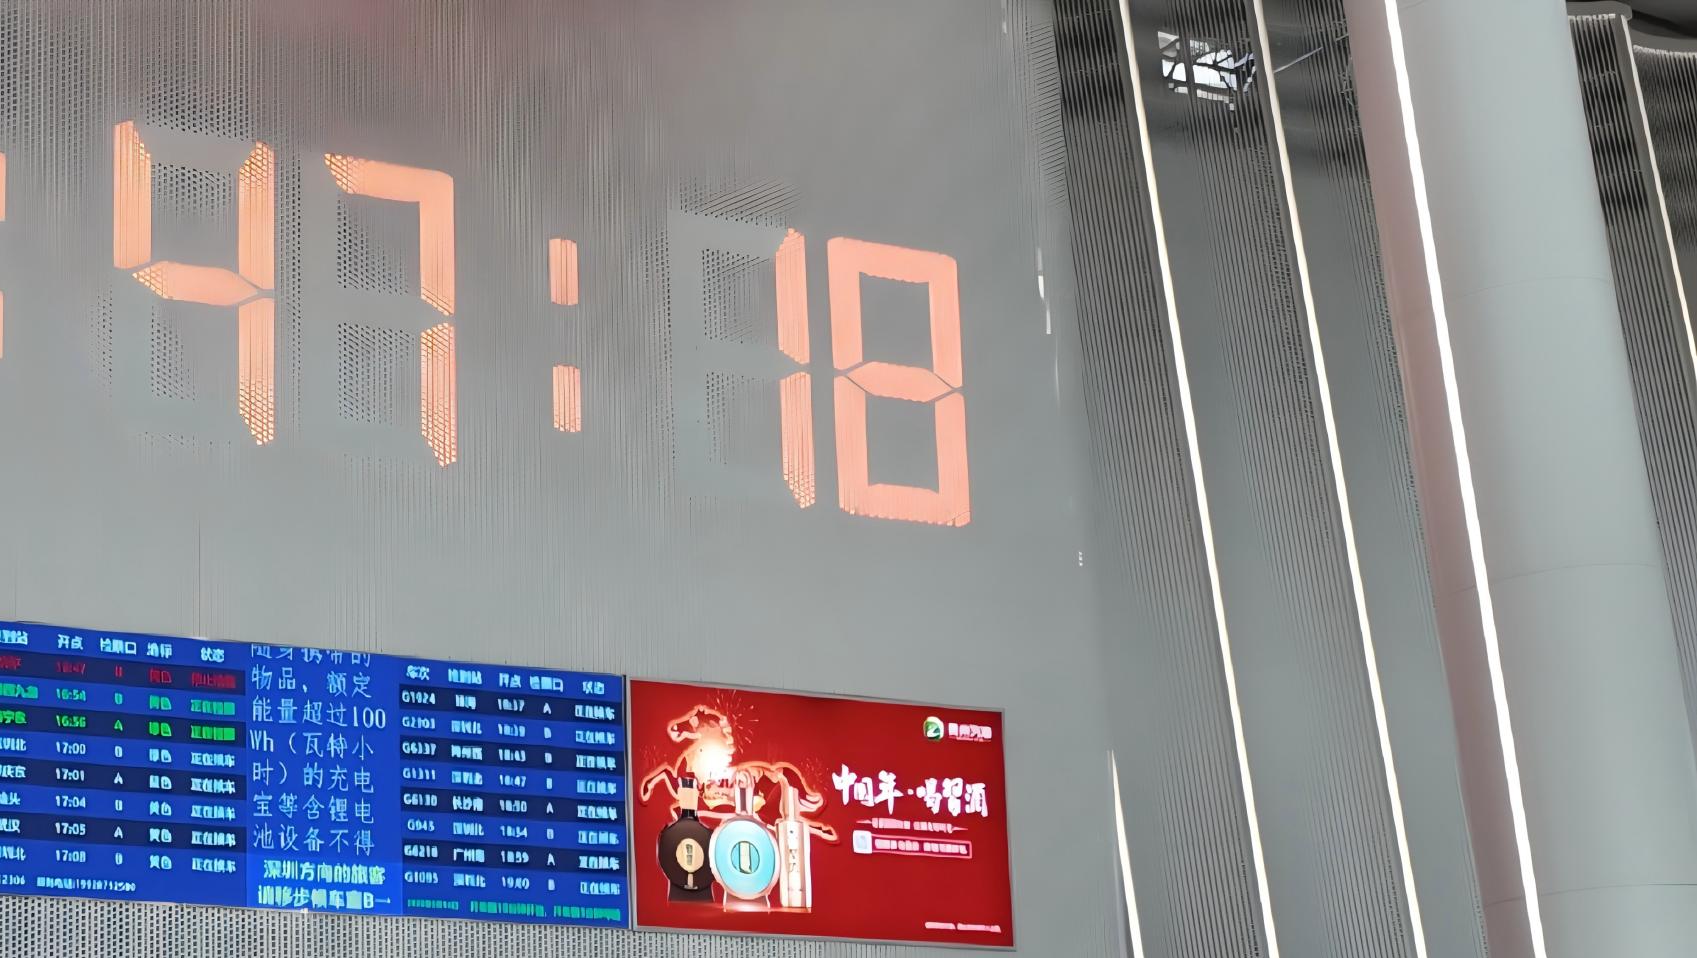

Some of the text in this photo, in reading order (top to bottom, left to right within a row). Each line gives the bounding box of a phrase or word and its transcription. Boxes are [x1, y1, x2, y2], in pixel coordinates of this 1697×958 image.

[55, 741, 87, 755] 17:00
[55, 767, 86, 782] 17:01
[55, 795, 87, 809] 17:04
[54, 822, 87, 836] 17:05
